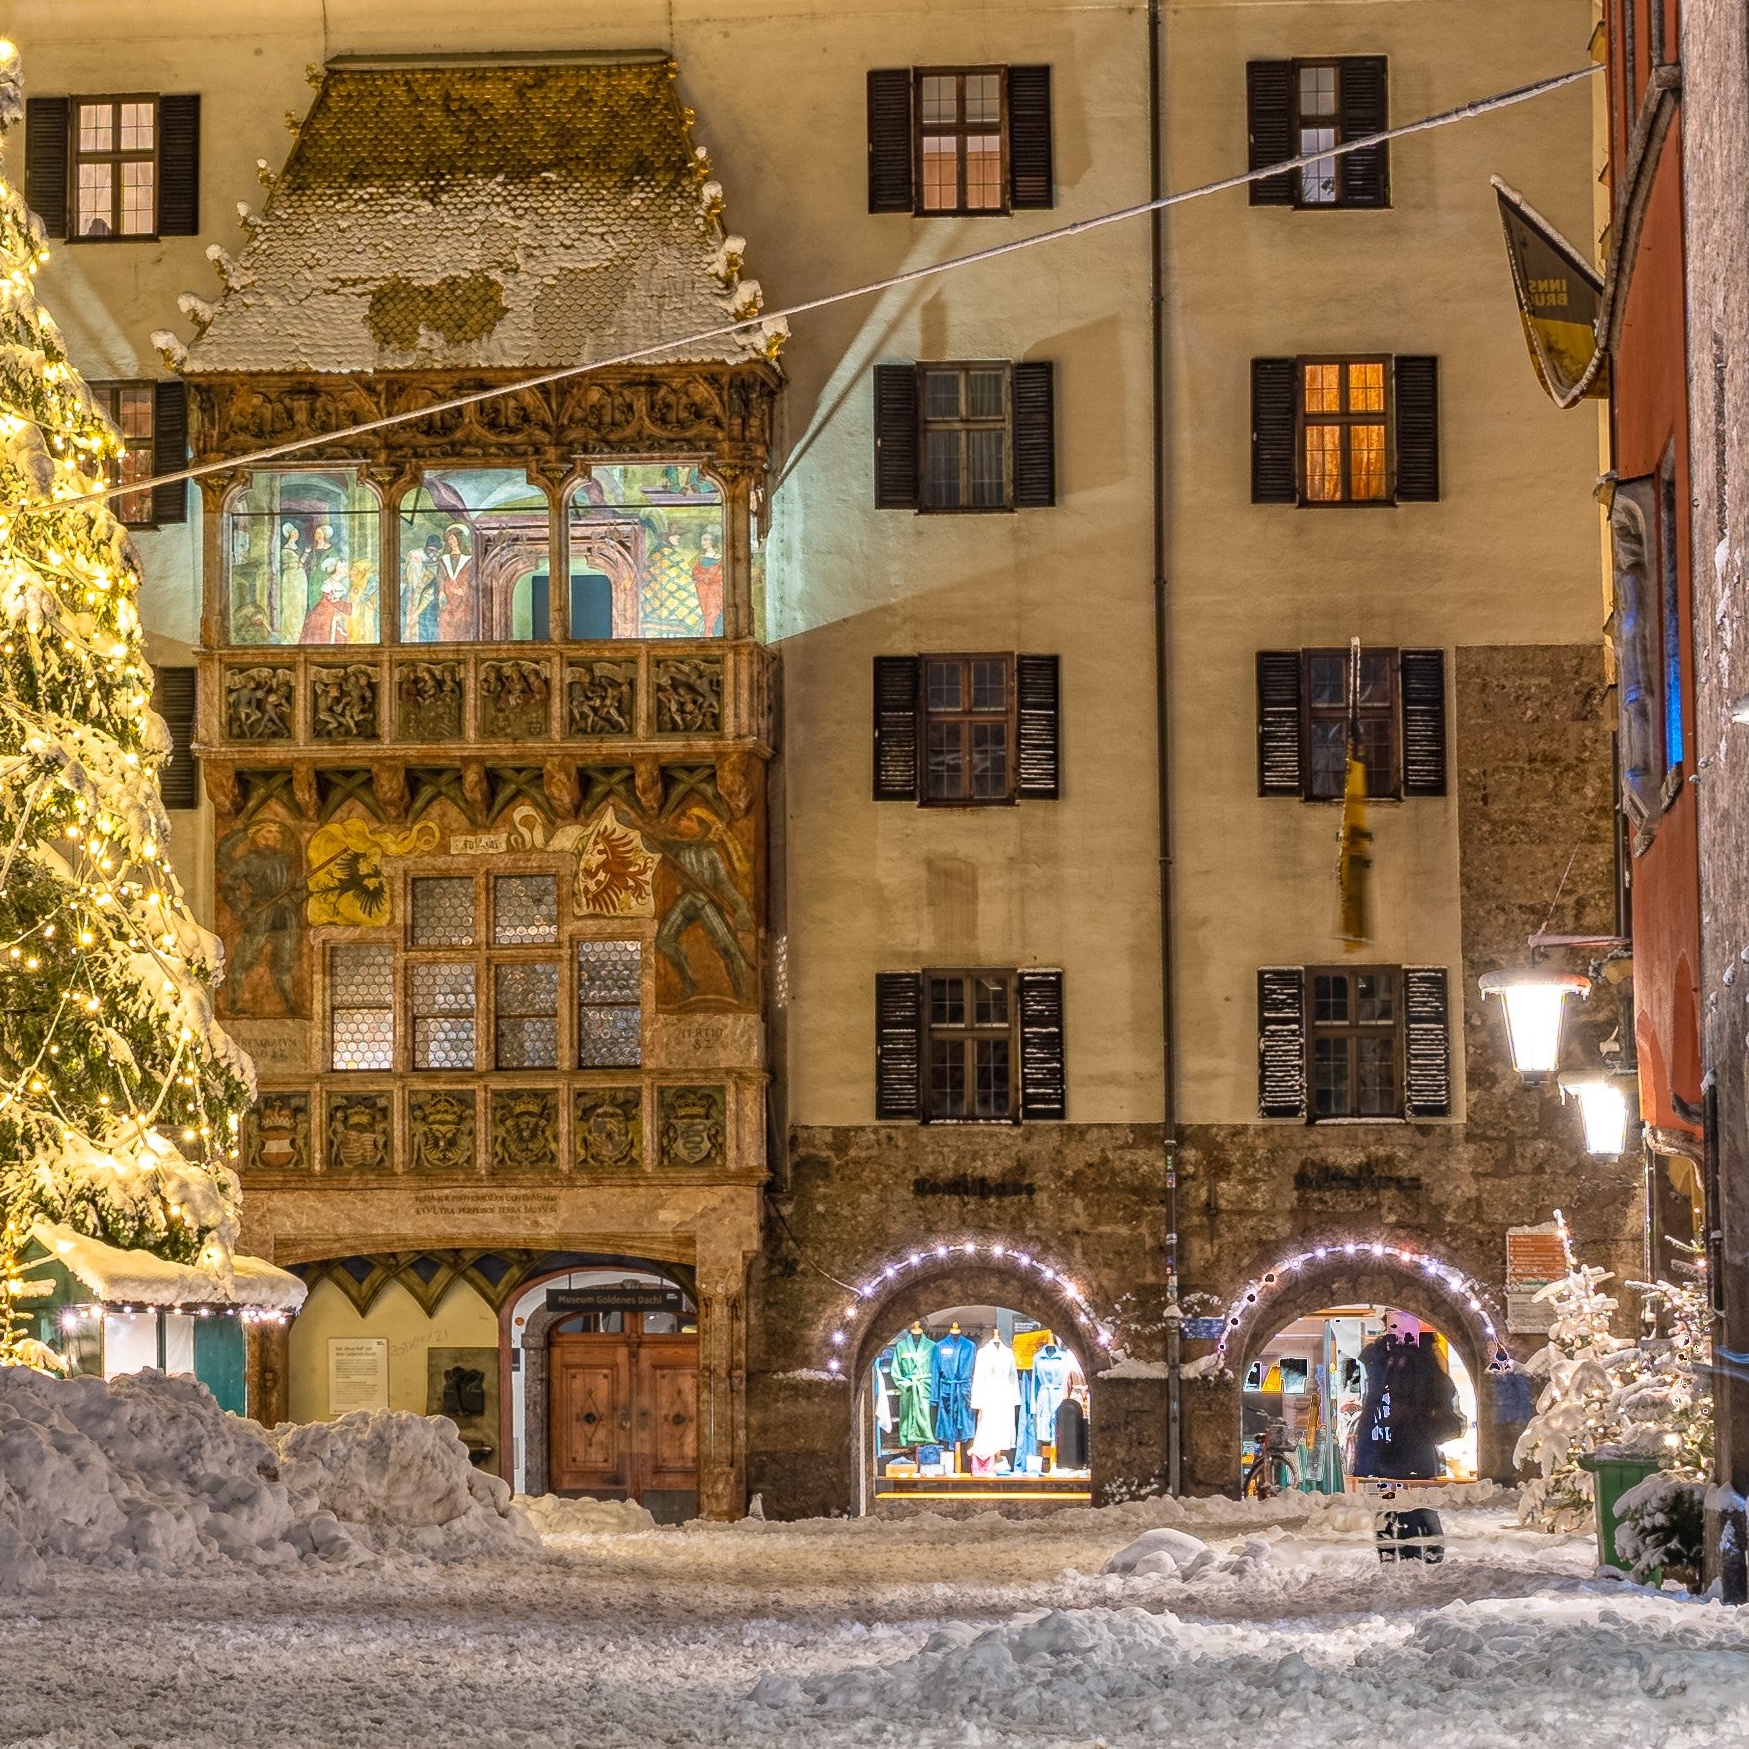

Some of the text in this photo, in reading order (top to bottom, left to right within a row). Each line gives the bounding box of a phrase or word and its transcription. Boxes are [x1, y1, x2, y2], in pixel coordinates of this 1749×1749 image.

[558, 1295, 595, 1305] Museum
[596, 1294, 637, 1305] Goldenes
[638, 1294, 663, 1305] Dachl
